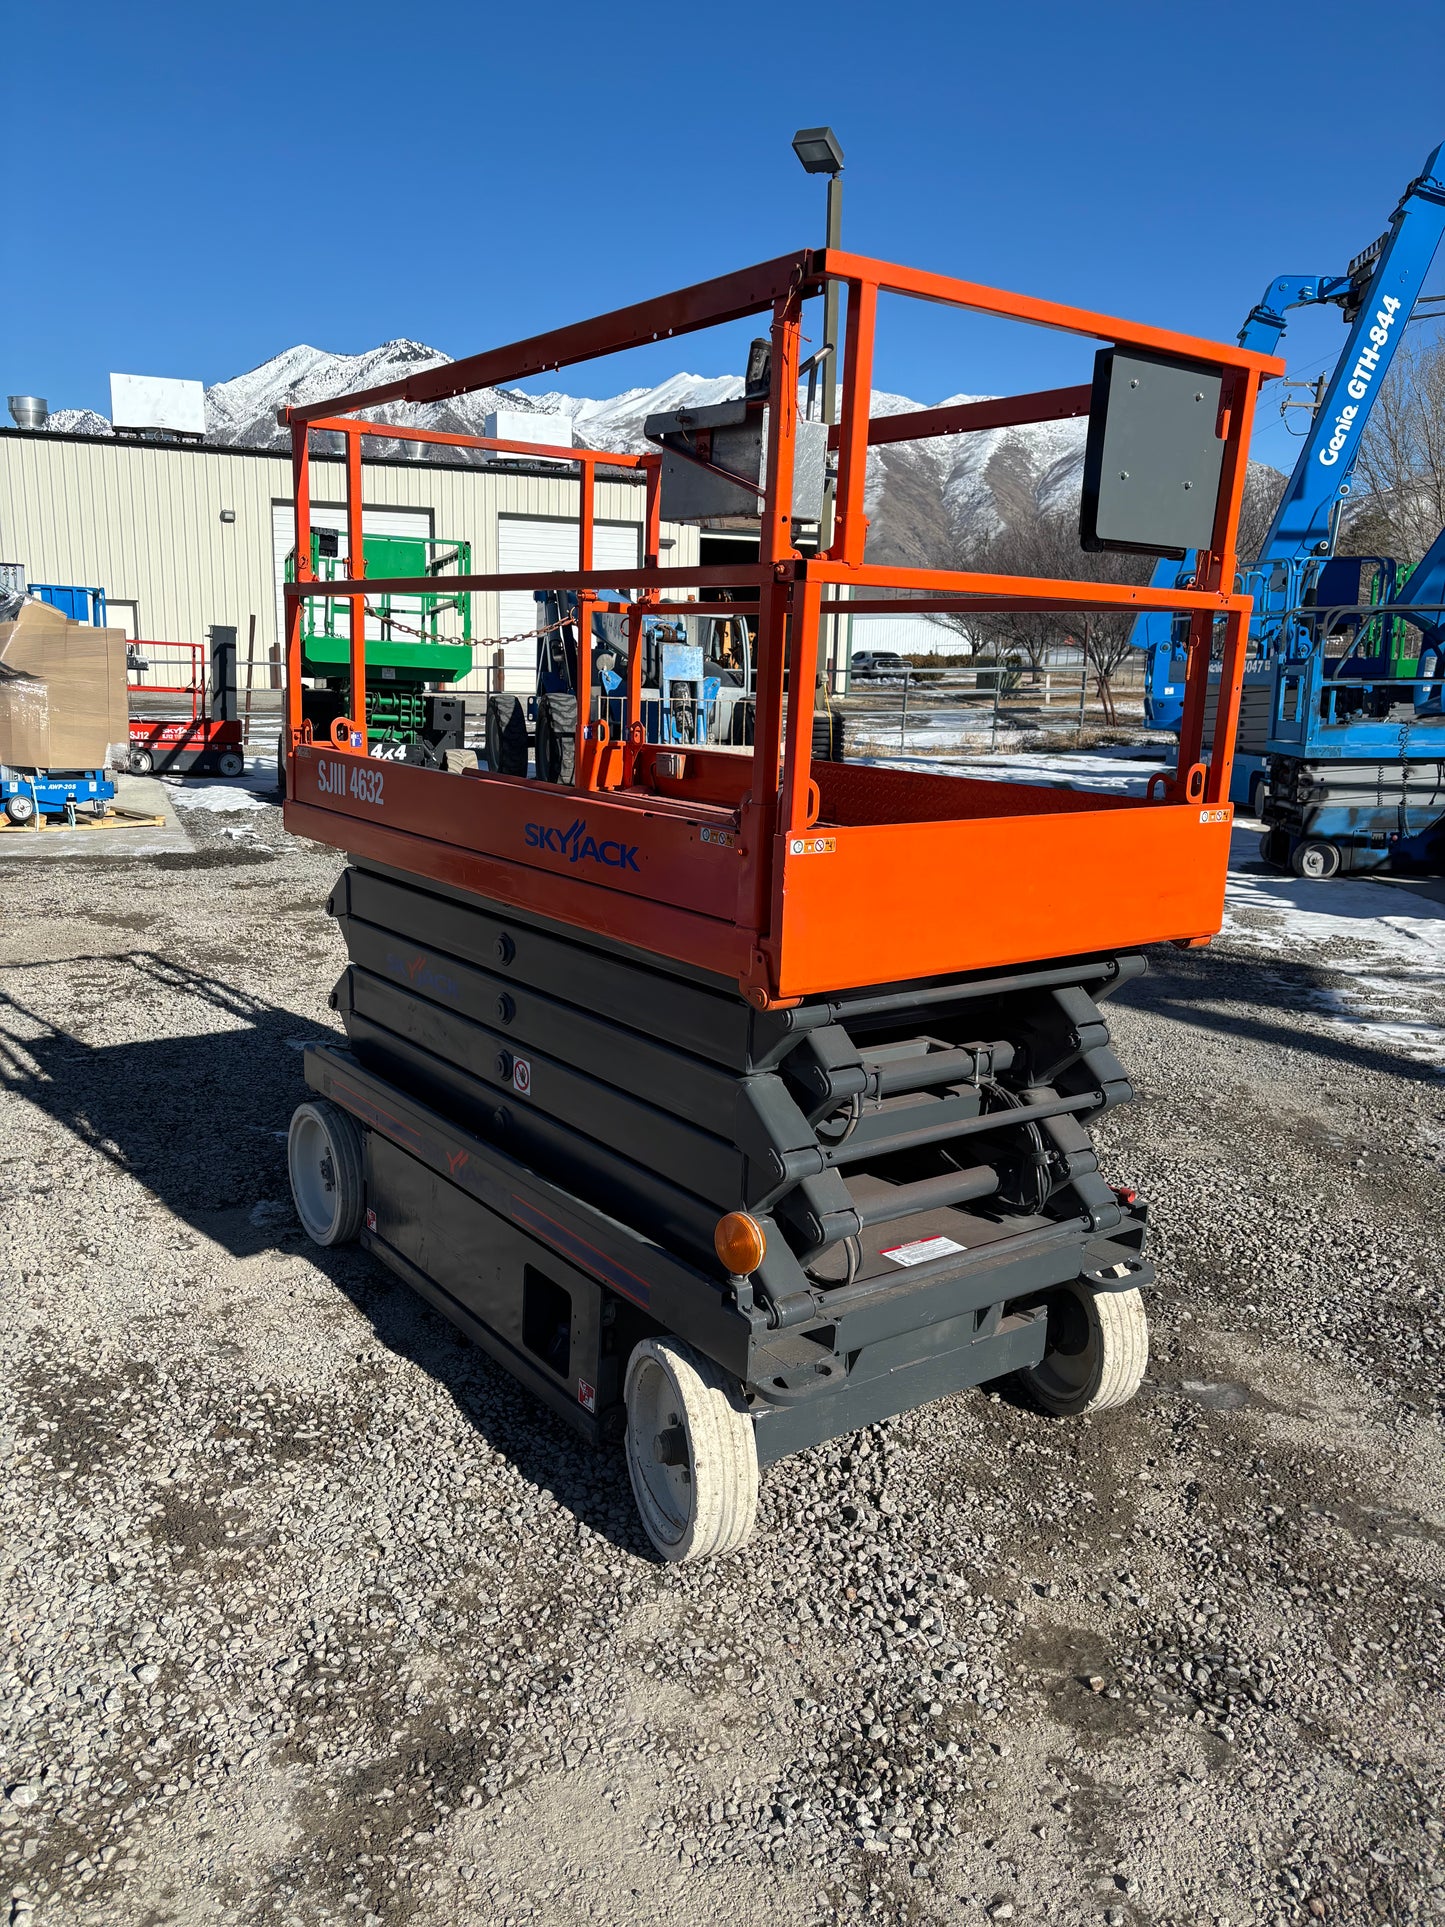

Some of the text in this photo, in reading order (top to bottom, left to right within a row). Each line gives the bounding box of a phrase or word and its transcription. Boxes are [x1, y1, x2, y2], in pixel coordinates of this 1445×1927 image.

[1319, 294, 1401, 466] Genie GTH-844
[129, 730, 150, 740] SJ12
[370, 743, 407, 761] 4x4
[318, 759, 384, 805] SJIII 4632
[525, 818, 640, 872] SKYJACK
